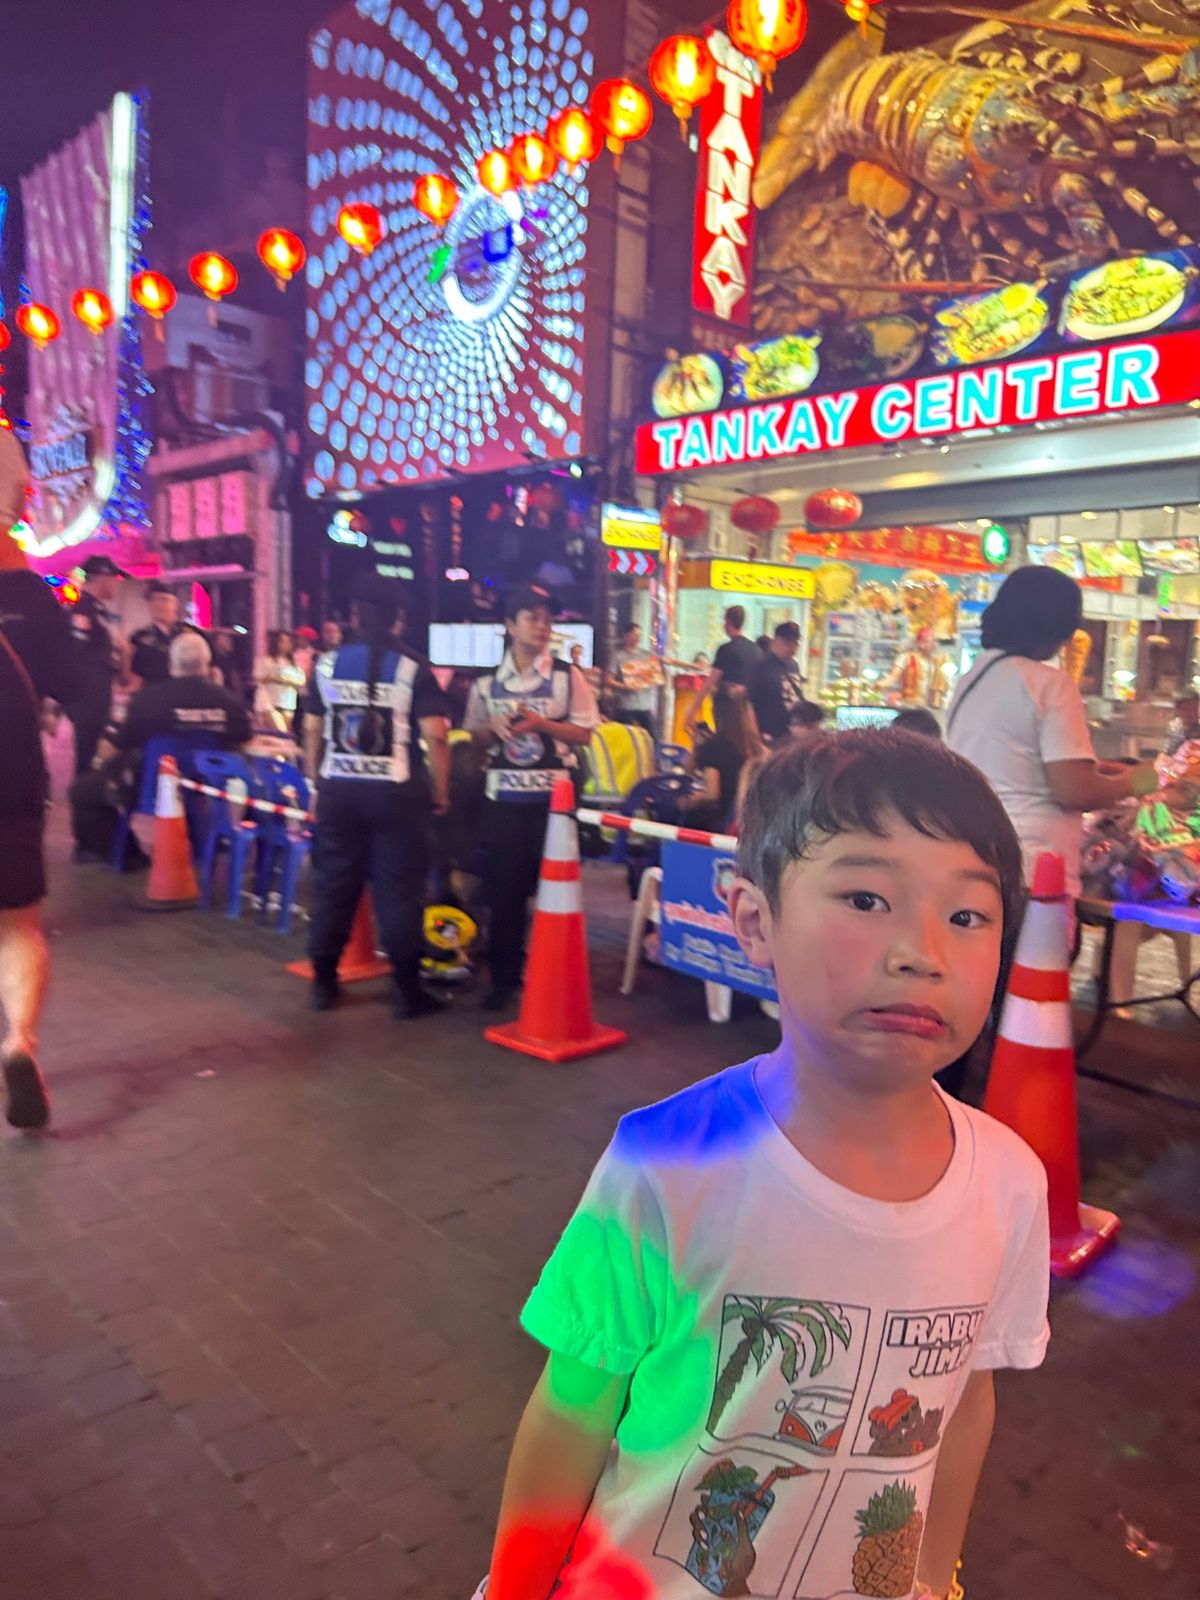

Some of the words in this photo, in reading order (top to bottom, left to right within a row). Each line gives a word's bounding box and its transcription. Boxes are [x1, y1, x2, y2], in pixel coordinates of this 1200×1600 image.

[700, 65, 754, 321] TANKAY
[652, 393, 858, 470] TANKAY
[871, 344, 1160, 439] CENTER
[722, 570, 805, 593] EXCHANGE
[334, 758, 391, 776] POLICE
[499, 771, 553, 788] POLICE
